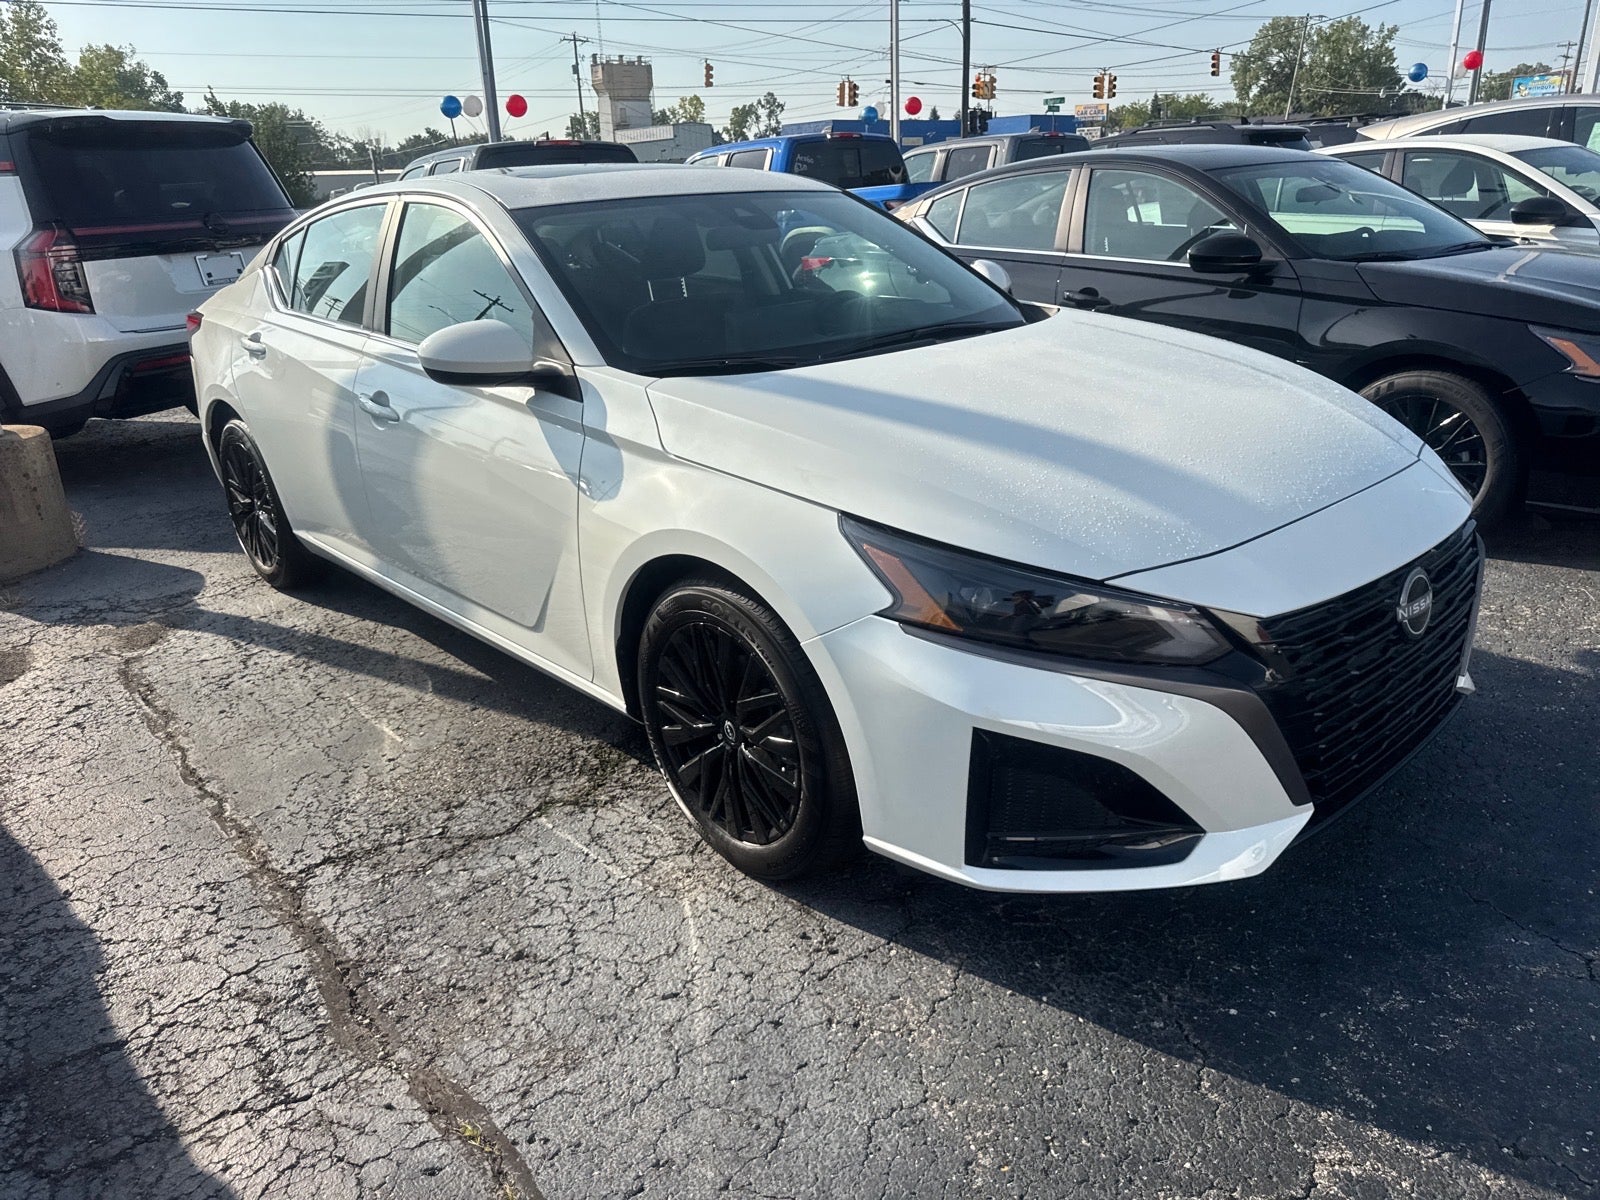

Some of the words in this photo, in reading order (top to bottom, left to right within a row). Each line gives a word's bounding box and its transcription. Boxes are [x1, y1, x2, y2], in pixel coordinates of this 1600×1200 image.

[1076, 109, 1088, 117] CAR
[1089, 108, 1105, 116] CARE
[1398, 595, 1431, 620] NISSA
